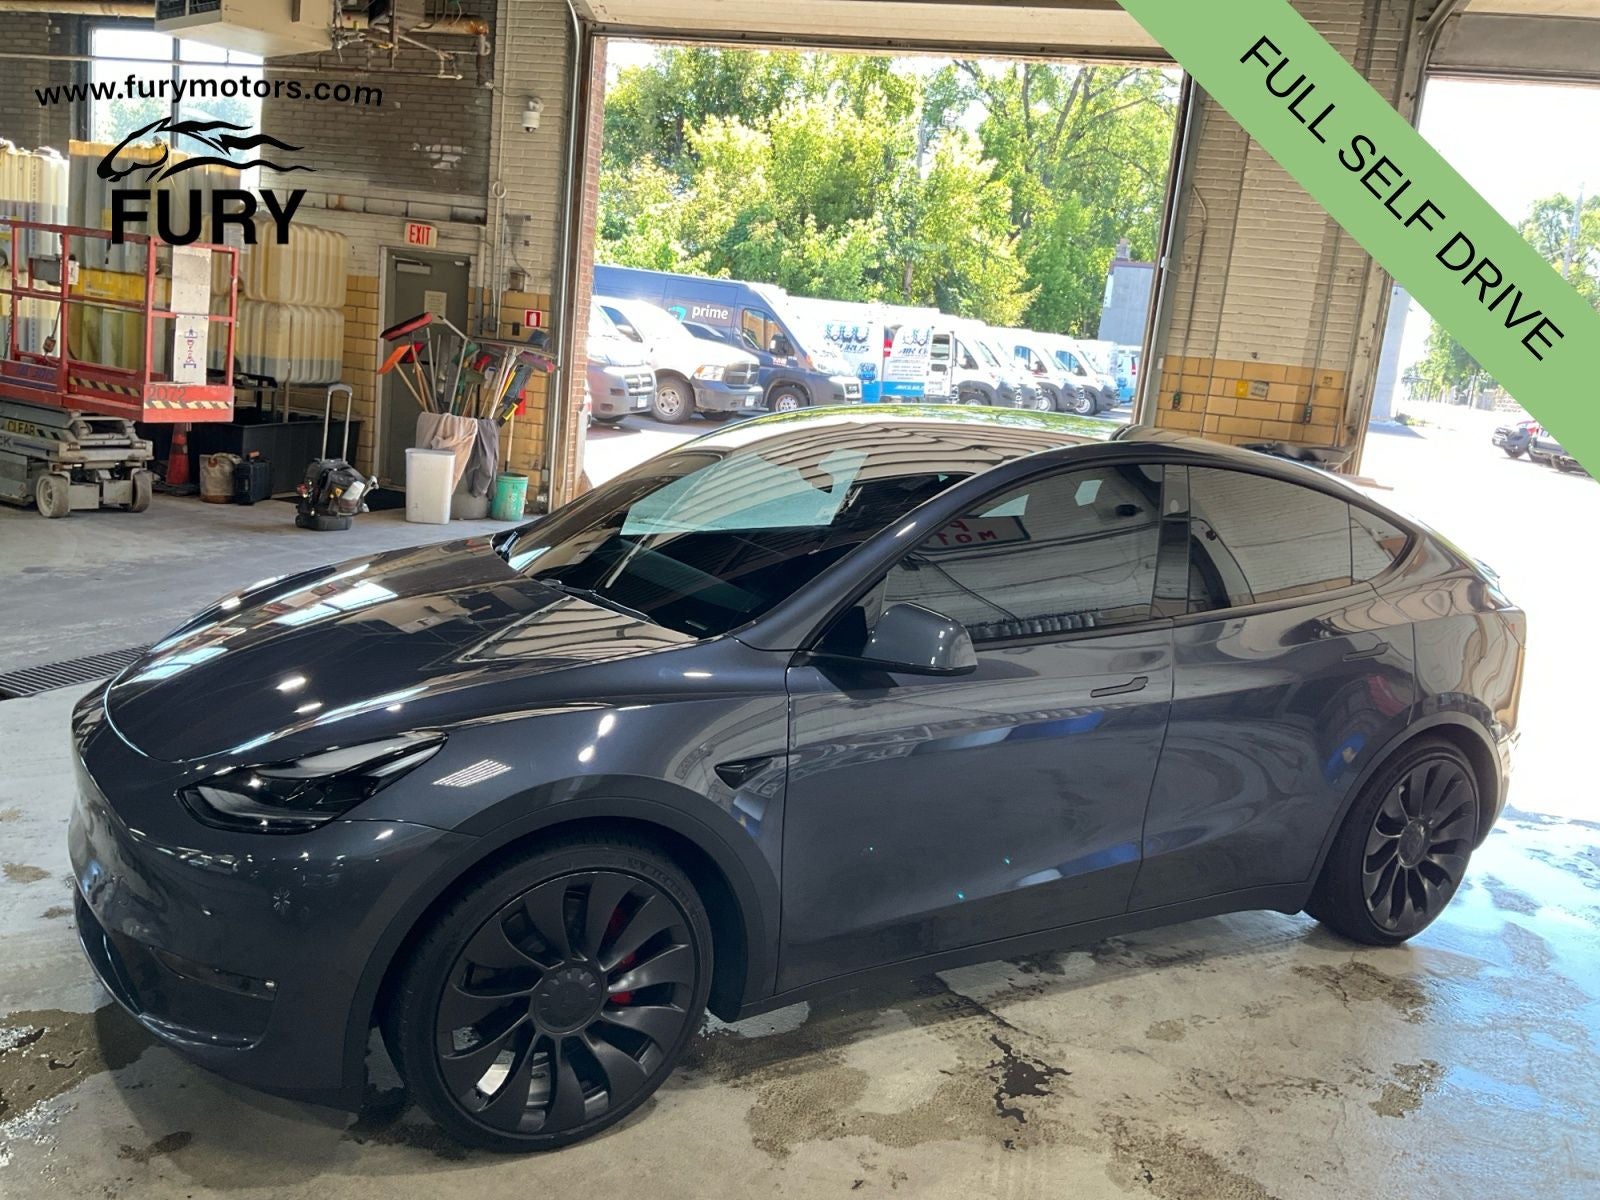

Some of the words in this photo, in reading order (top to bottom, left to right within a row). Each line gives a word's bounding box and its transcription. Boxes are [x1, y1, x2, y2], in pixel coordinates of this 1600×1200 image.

[409, 224, 432, 246] EXIT
[691, 304, 729, 320] prime
[7, 420, 36, 437] CLEAR
